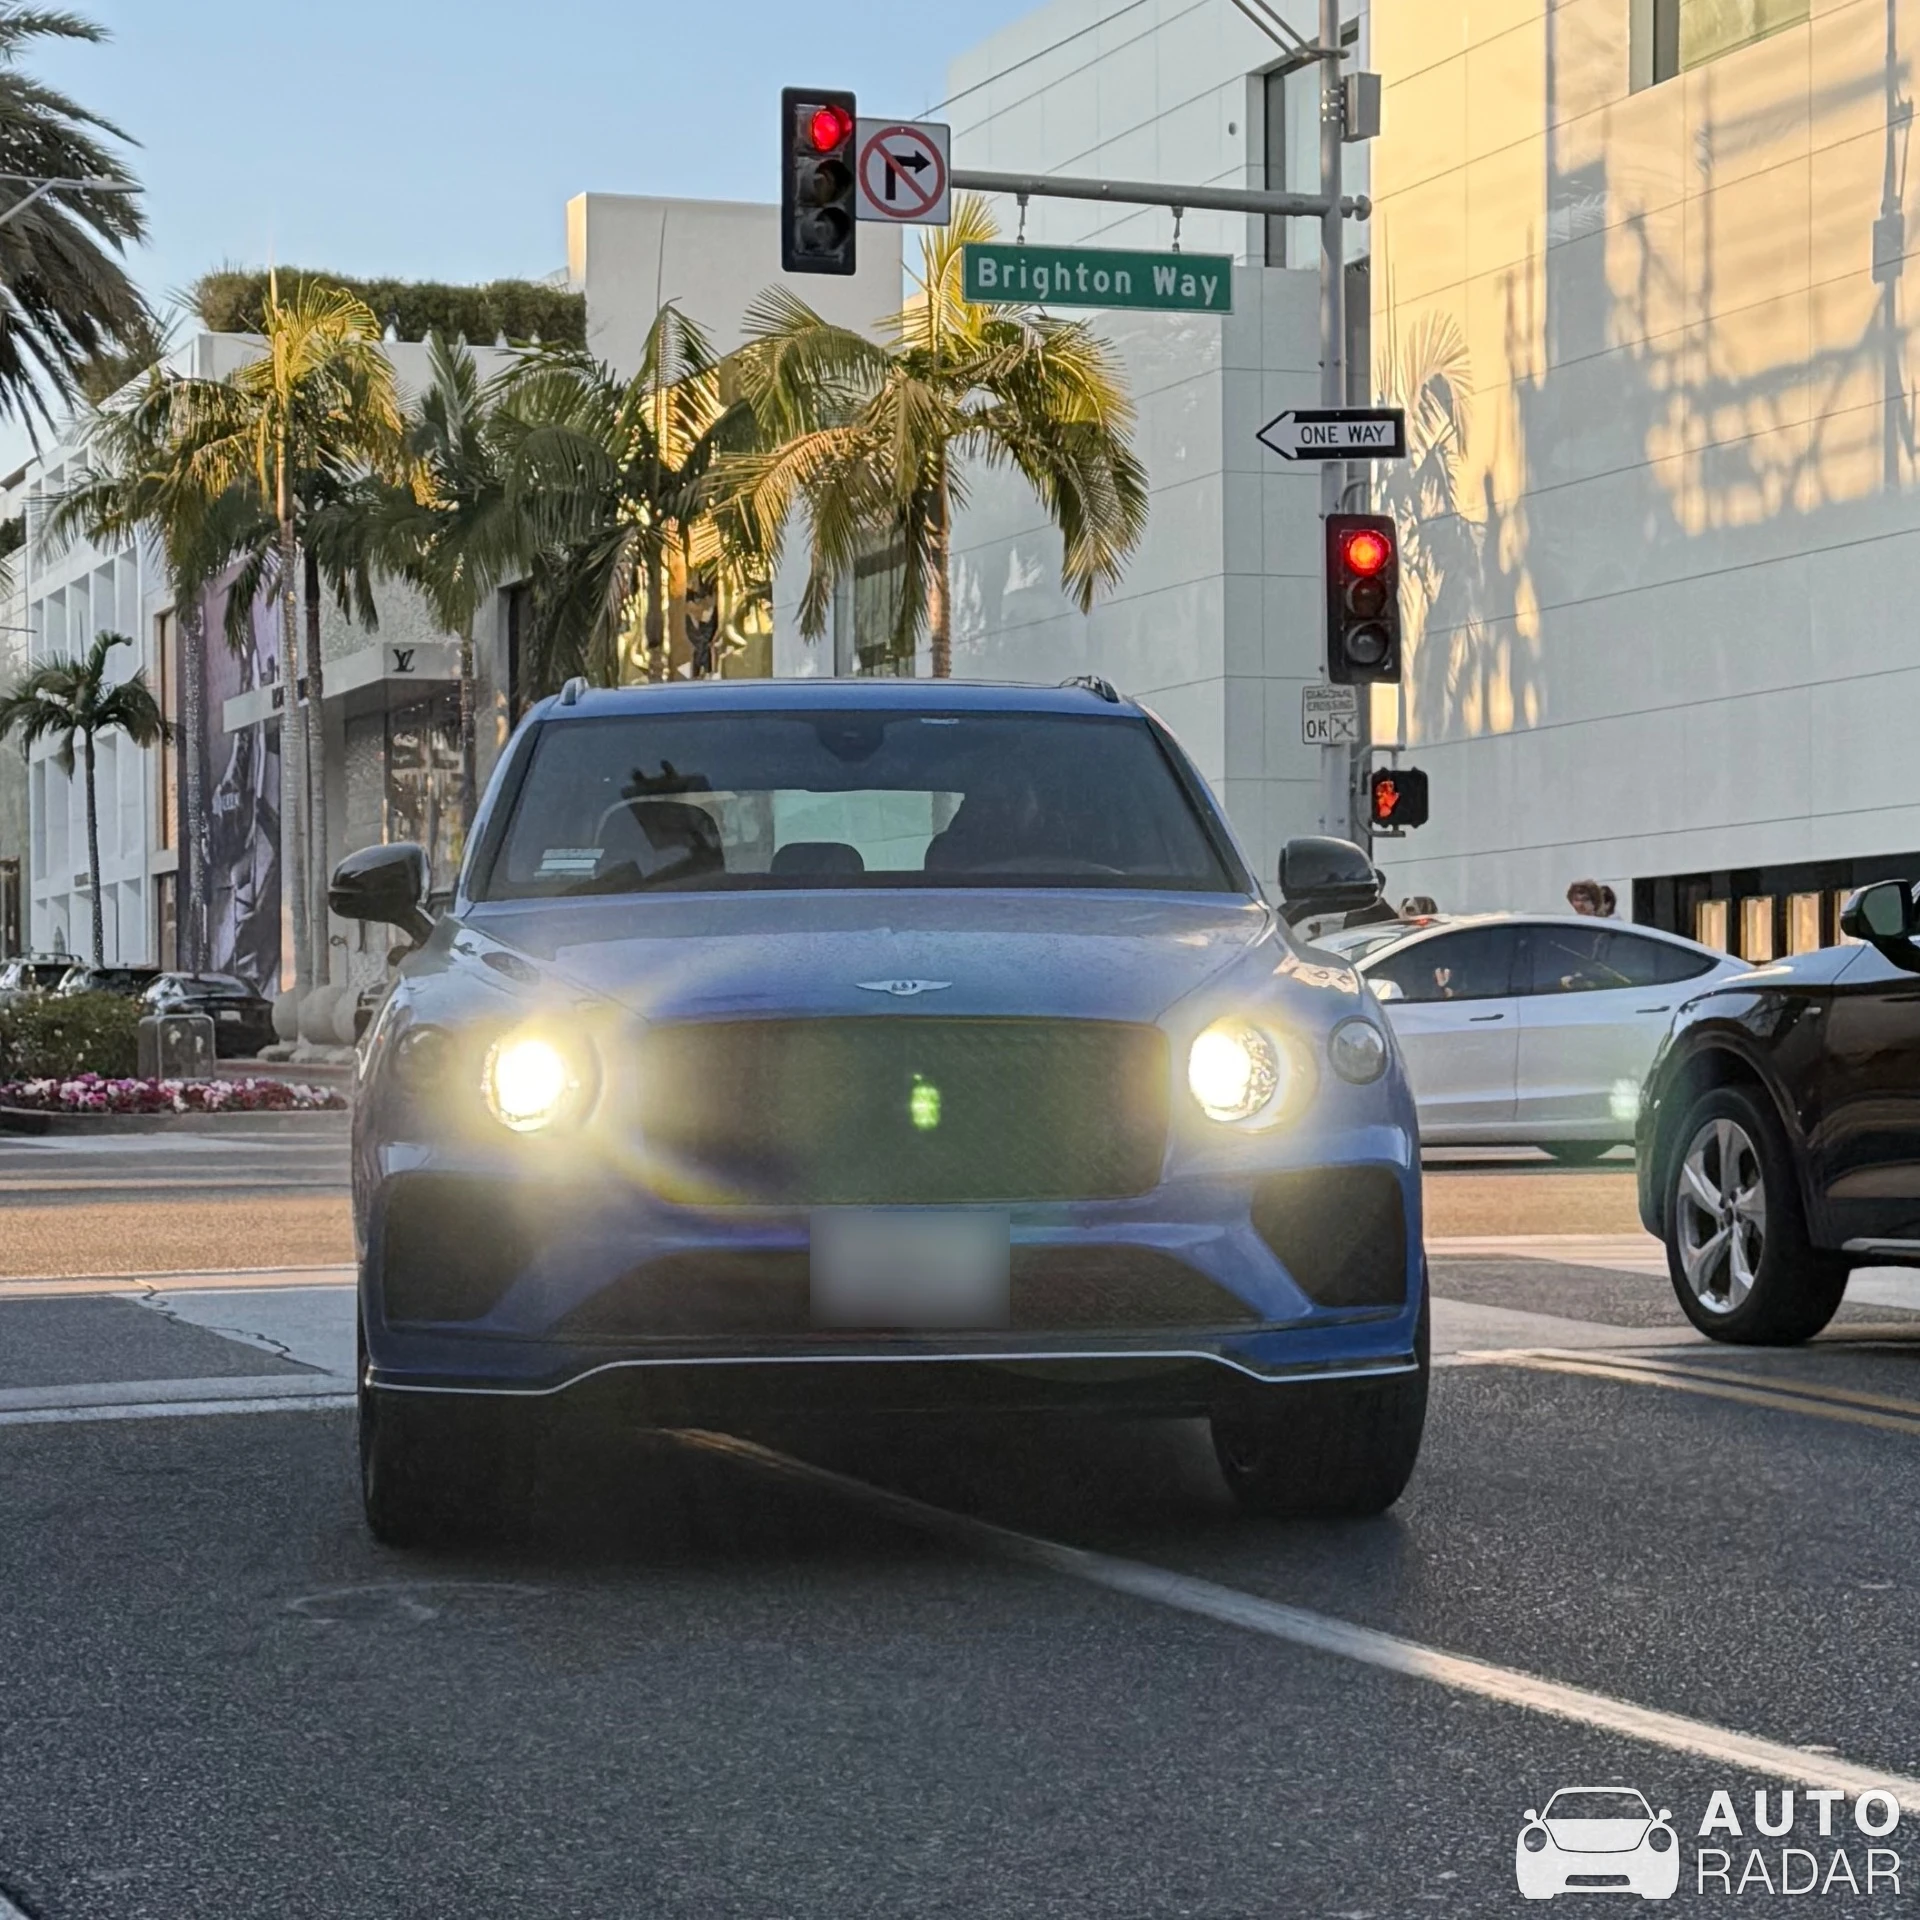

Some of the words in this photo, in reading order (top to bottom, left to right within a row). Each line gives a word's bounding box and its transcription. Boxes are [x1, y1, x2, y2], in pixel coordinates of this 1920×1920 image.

[978, 257, 1131, 299] Brighton
[1153, 265, 1218, 306] Way
[1300, 425, 1339, 444] ONE
[1348, 424, 1386, 443] WAY
[1306, 719, 1328, 738] OK
